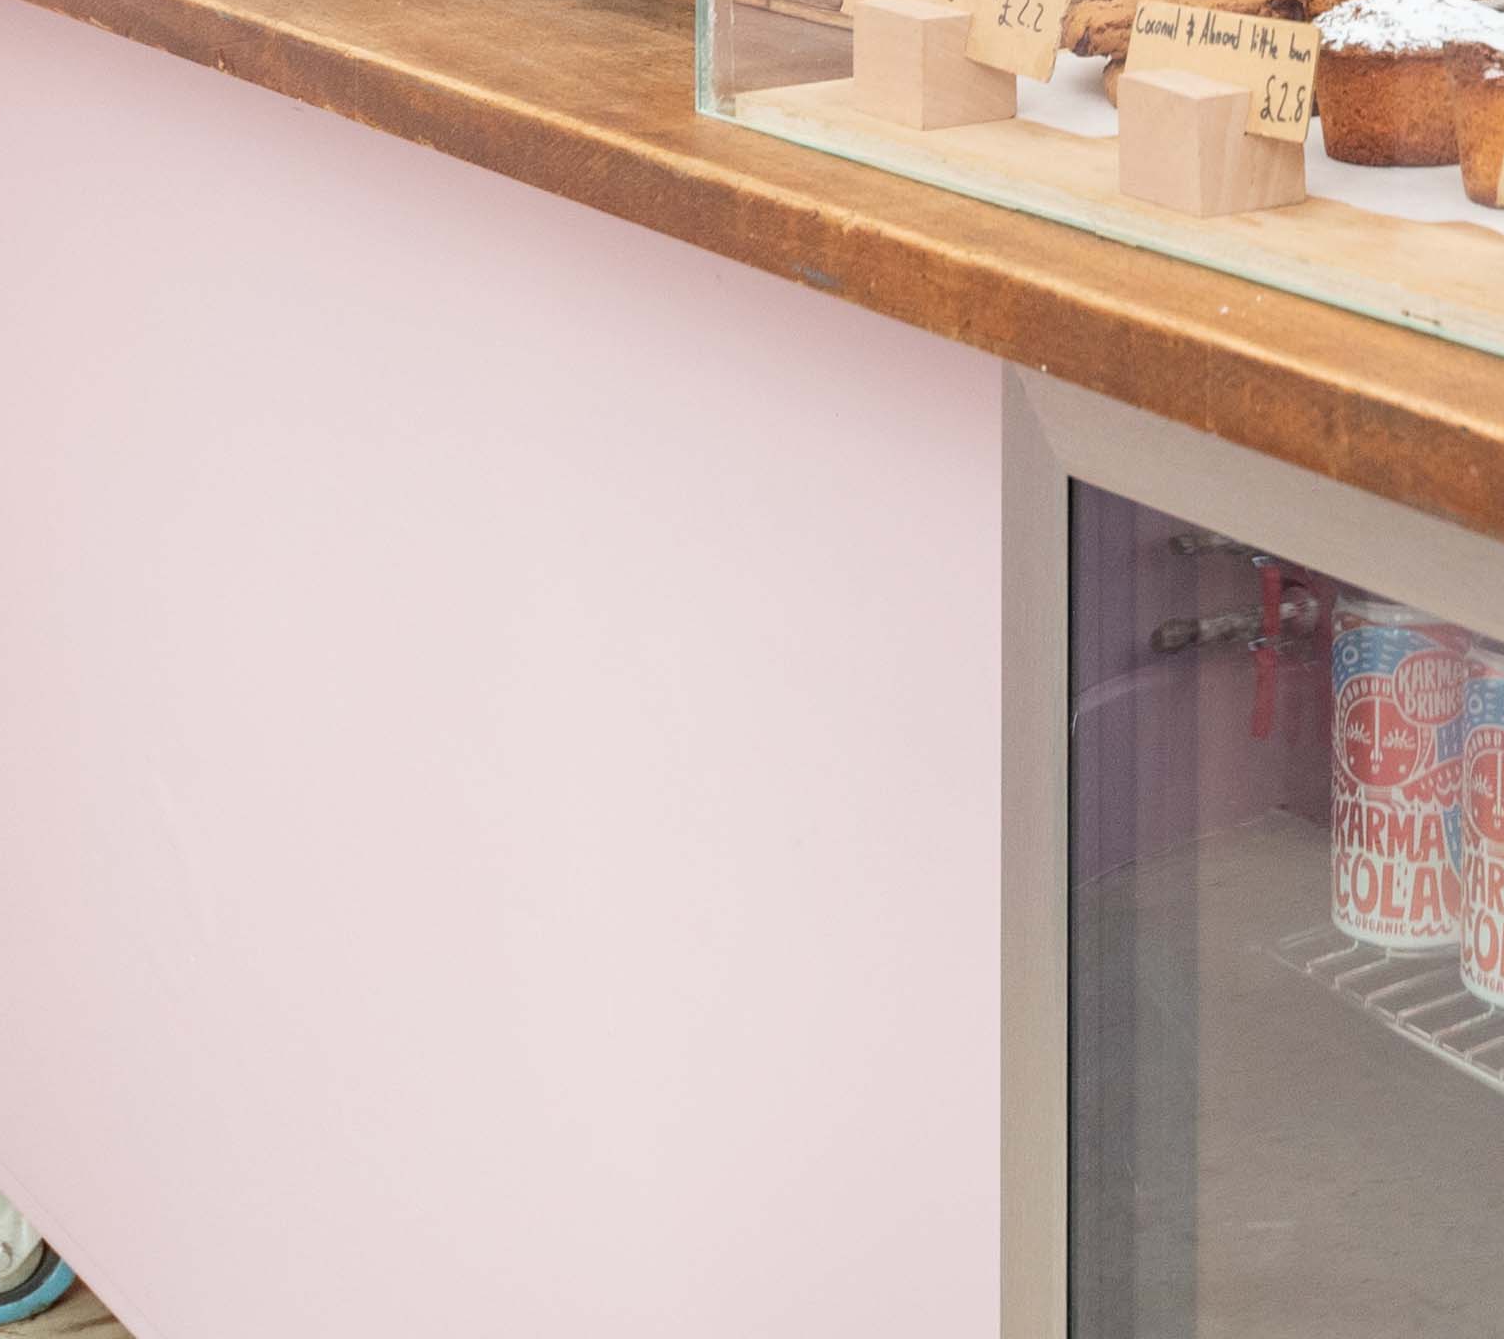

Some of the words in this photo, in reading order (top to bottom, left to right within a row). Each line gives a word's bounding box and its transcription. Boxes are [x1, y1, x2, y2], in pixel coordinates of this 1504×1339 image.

[1288, 31, 1312, 65] bun
[1259, 74, 1307, 124] £2.8
[1334, 798, 1446, 865] KARMA
[1334, 851, 1443, 924] COLA
